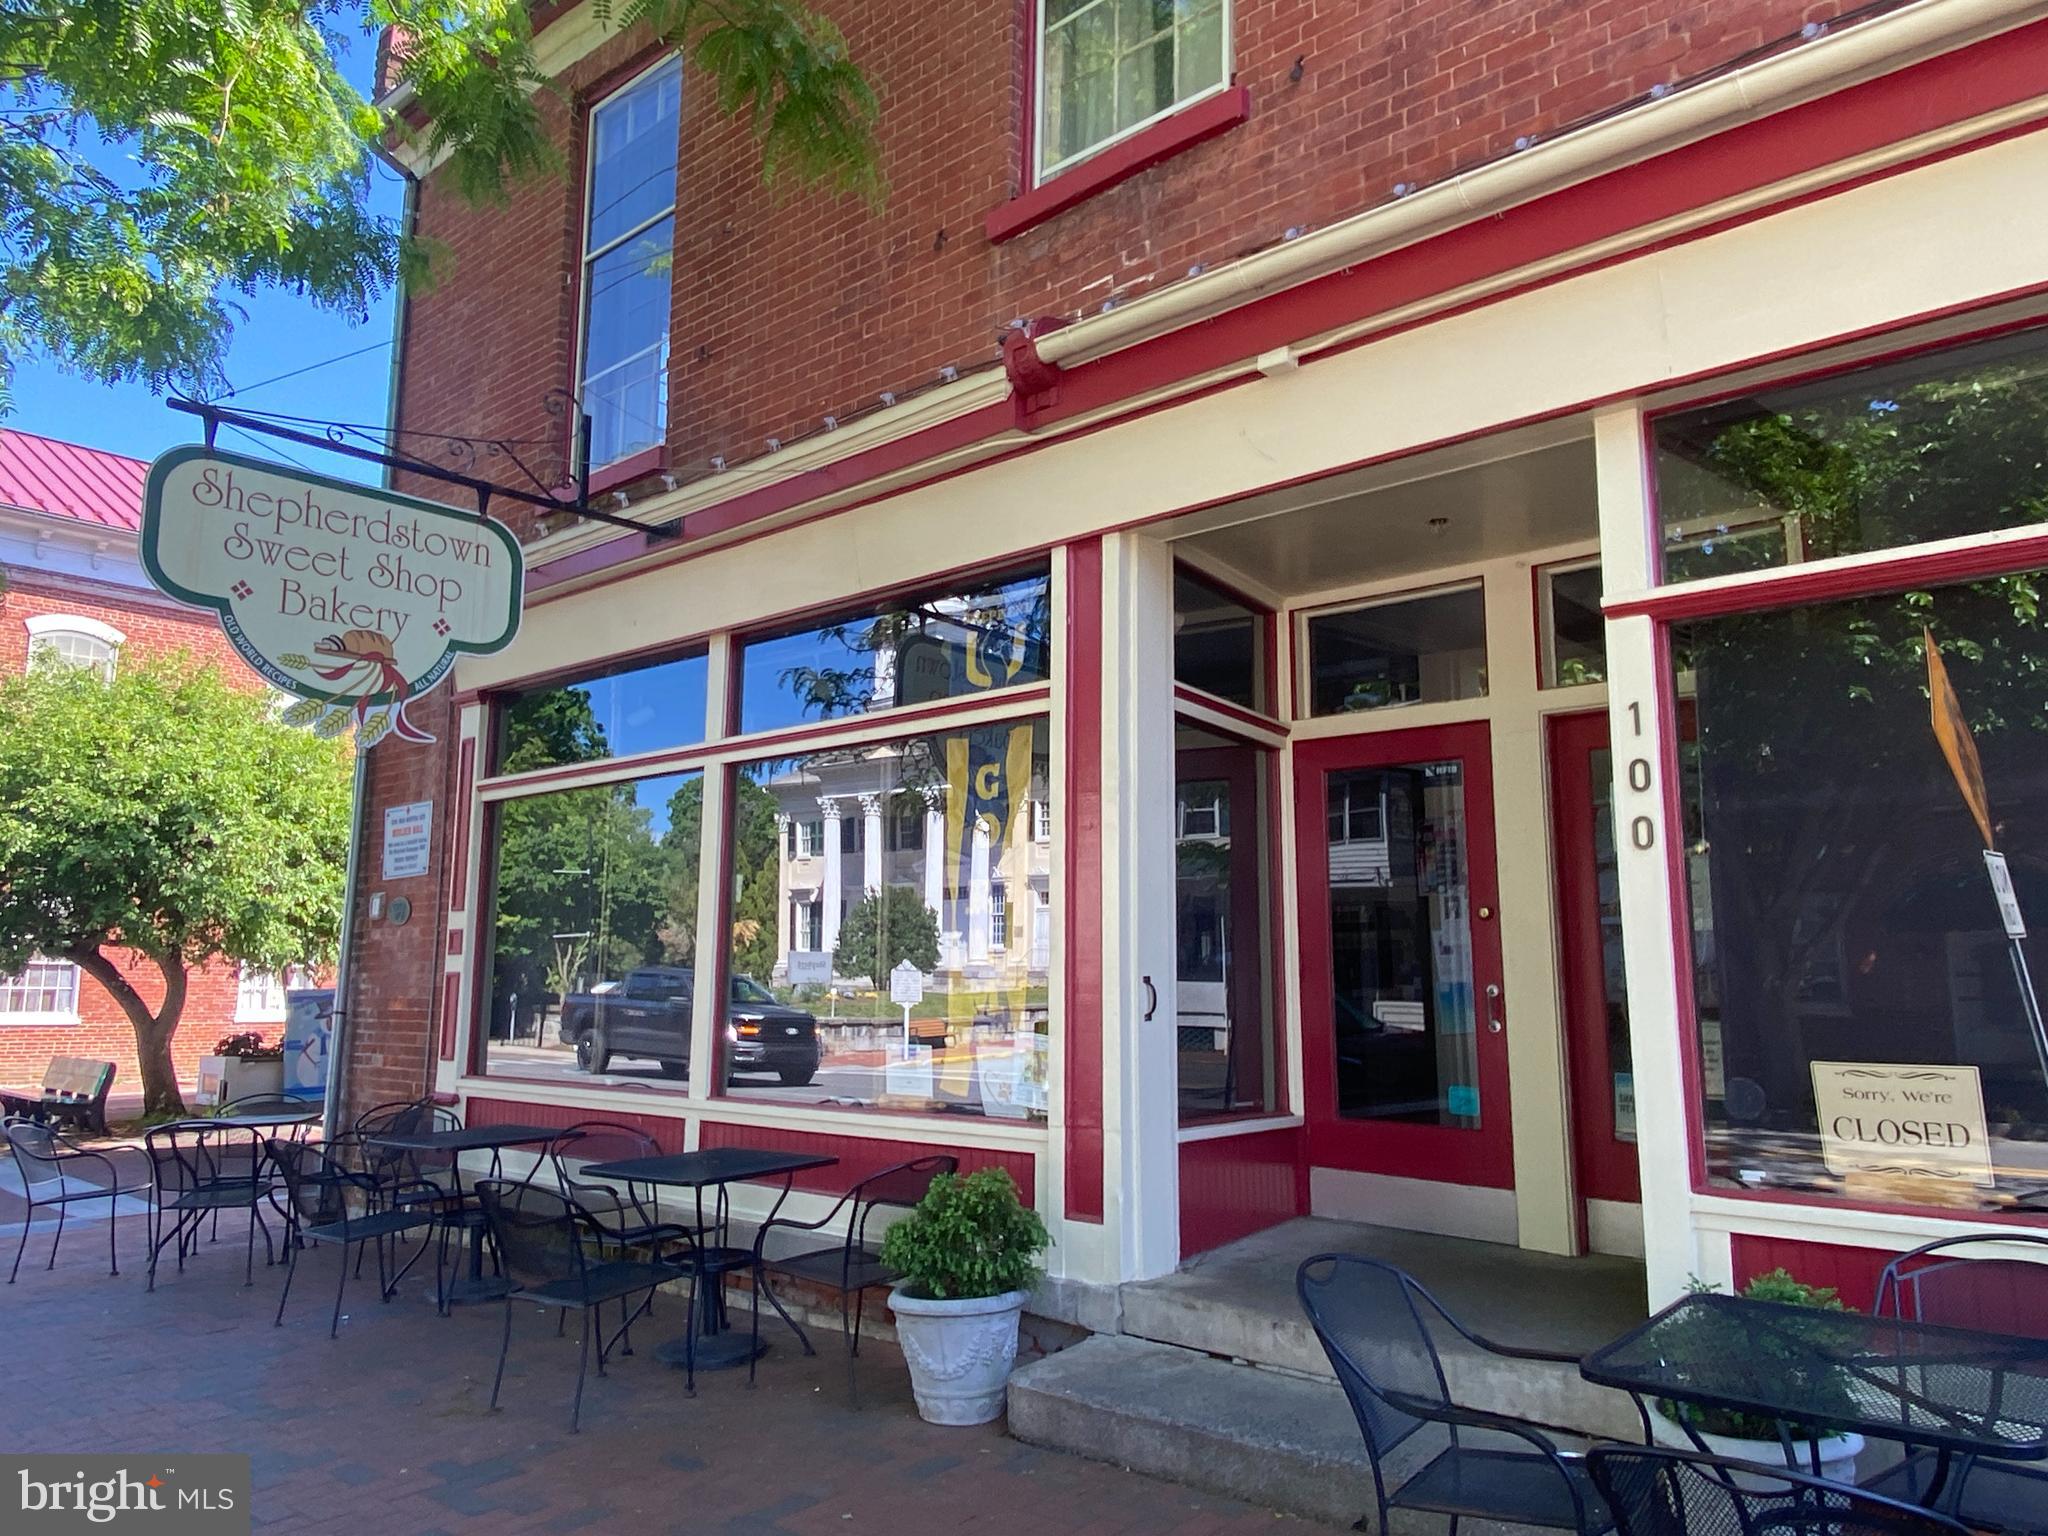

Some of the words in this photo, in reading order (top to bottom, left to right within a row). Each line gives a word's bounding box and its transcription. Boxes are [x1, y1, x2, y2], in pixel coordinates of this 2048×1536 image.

[191, 467, 492, 568] Shepherdstown
[223, 521, 355, 582] Sweet
[367, 552, 463, 612] Shop
[277, 577, 412, 644] Bakery
[223, 614, 240, 635] OLD
[235, 634, 263, 666] WORLD
[261, 664, 298, 690] RECIPES
[414, 678, 430, 692] ALL
[427, 650, 455, 682] NATURAL
[1902, 1090, 1953, 1105] We're
[1832, 1115, 1972, 1149] CLOSED
